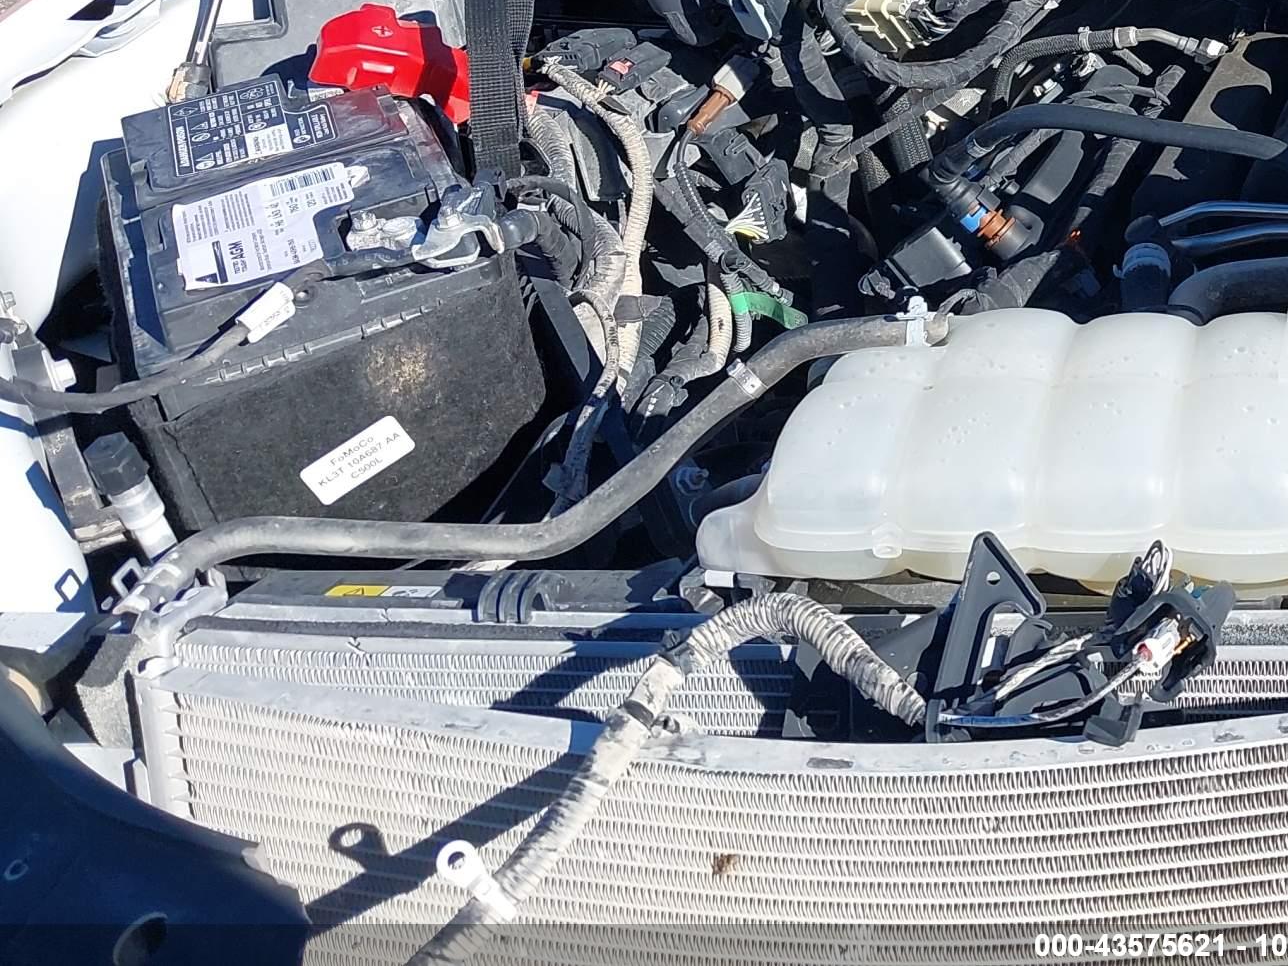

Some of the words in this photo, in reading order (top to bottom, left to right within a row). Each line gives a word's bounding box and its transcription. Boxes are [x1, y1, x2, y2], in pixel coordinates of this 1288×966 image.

[228, 239, 244, 261] AGM
[318, 466, 345, 487] KL3T
[347, 442, 382, 468] 10A687
[386, 432, 400, 445] AA
[330, 436, 374, 466] FoMoCo
[351, 456, 383, 479] C500L
